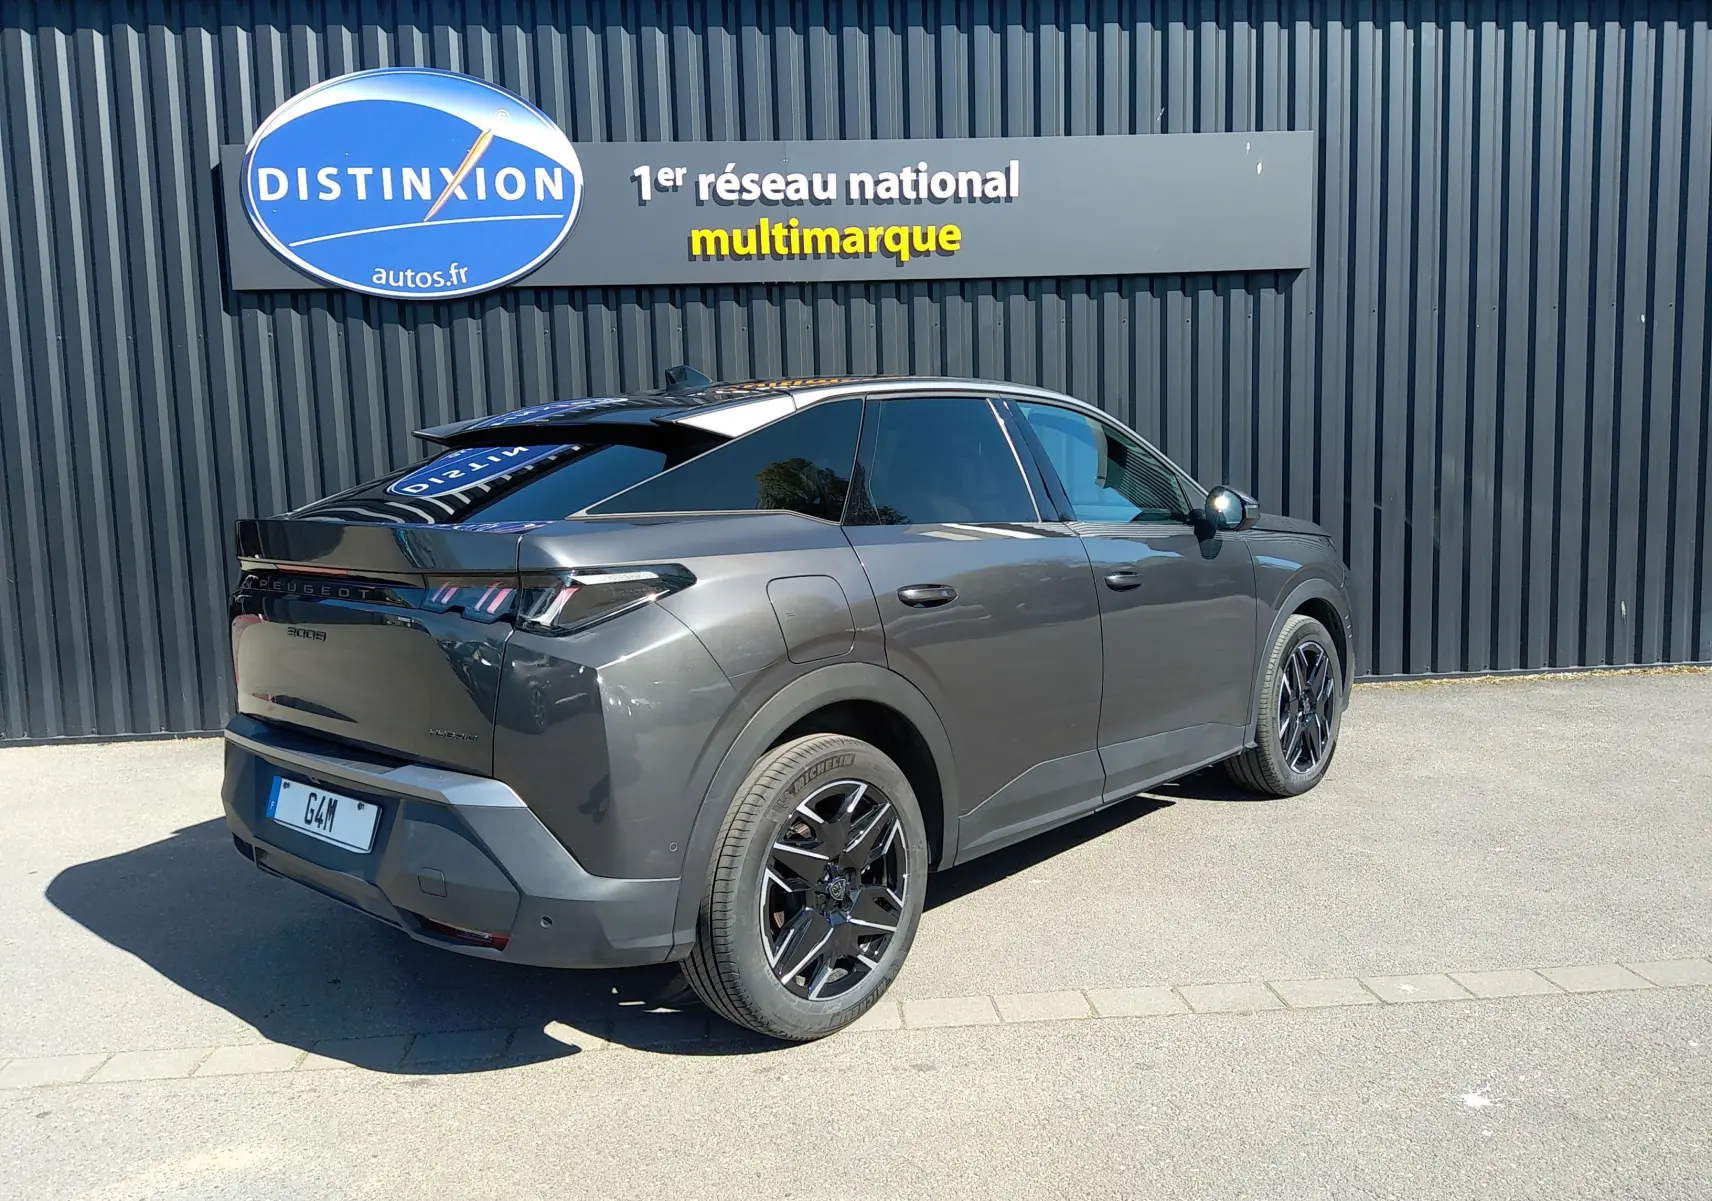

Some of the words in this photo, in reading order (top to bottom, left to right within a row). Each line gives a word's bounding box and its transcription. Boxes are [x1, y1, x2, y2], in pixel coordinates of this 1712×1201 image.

[257, 167, 564, 202] DISTINXION
[633, 165, 687, 201] 1er
[698, 162, 837, 201] réseau
[849, 160, 1020, 199] national
[691, 218, 962, 262] multimarque
[372, 262, 469, 289] autos.fr
[259, 579, 370, 599] PEUGEOT
[793, 755, 854, 794] MICHELIN
[303, 792, 338, 833] G4M
